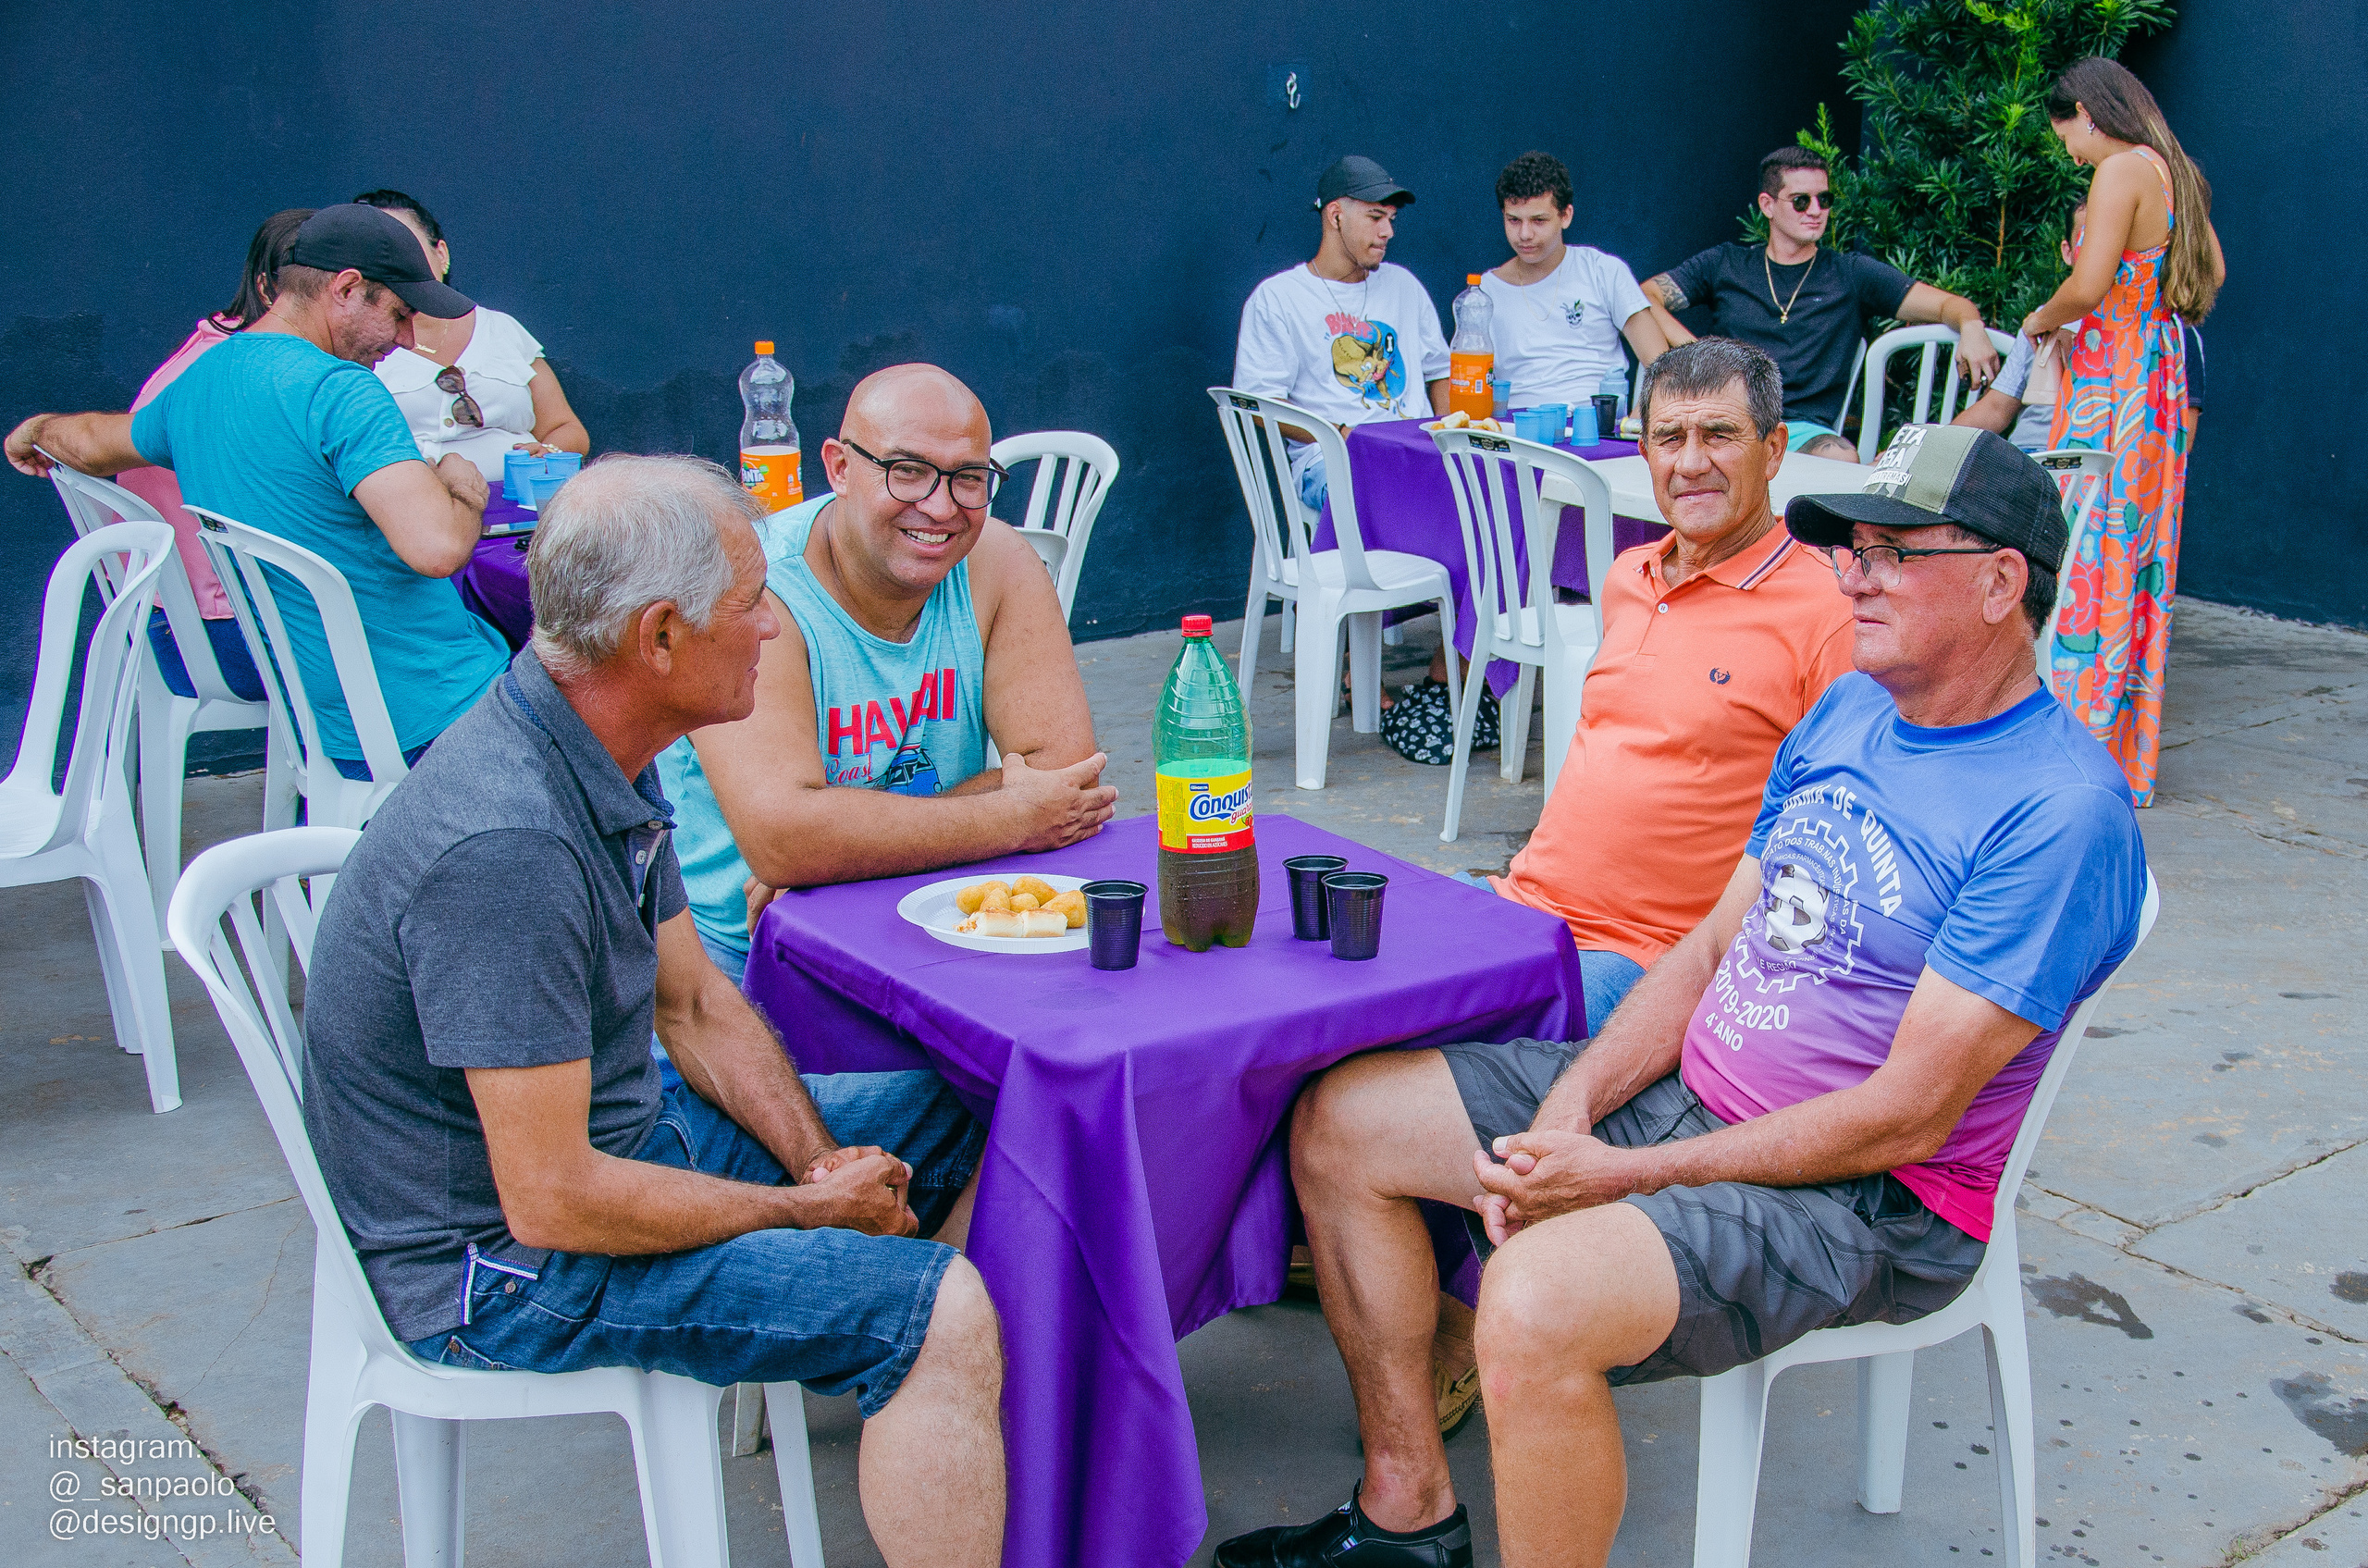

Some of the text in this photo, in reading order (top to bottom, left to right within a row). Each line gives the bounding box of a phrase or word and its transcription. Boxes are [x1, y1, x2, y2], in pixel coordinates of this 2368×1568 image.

[1190, 782, 1252, 821] Conquist
[1784, 836, 1804, 847] DOS
[1839, 919, 1848, 936] DA
[1832, 785, 1857, 821] DE
[1860, 809, 1903, 918] QUINTA
[1715, 959, 1790, 1031] 2019-2020
[1759, 957, 1796, 972] E REGIÃO
